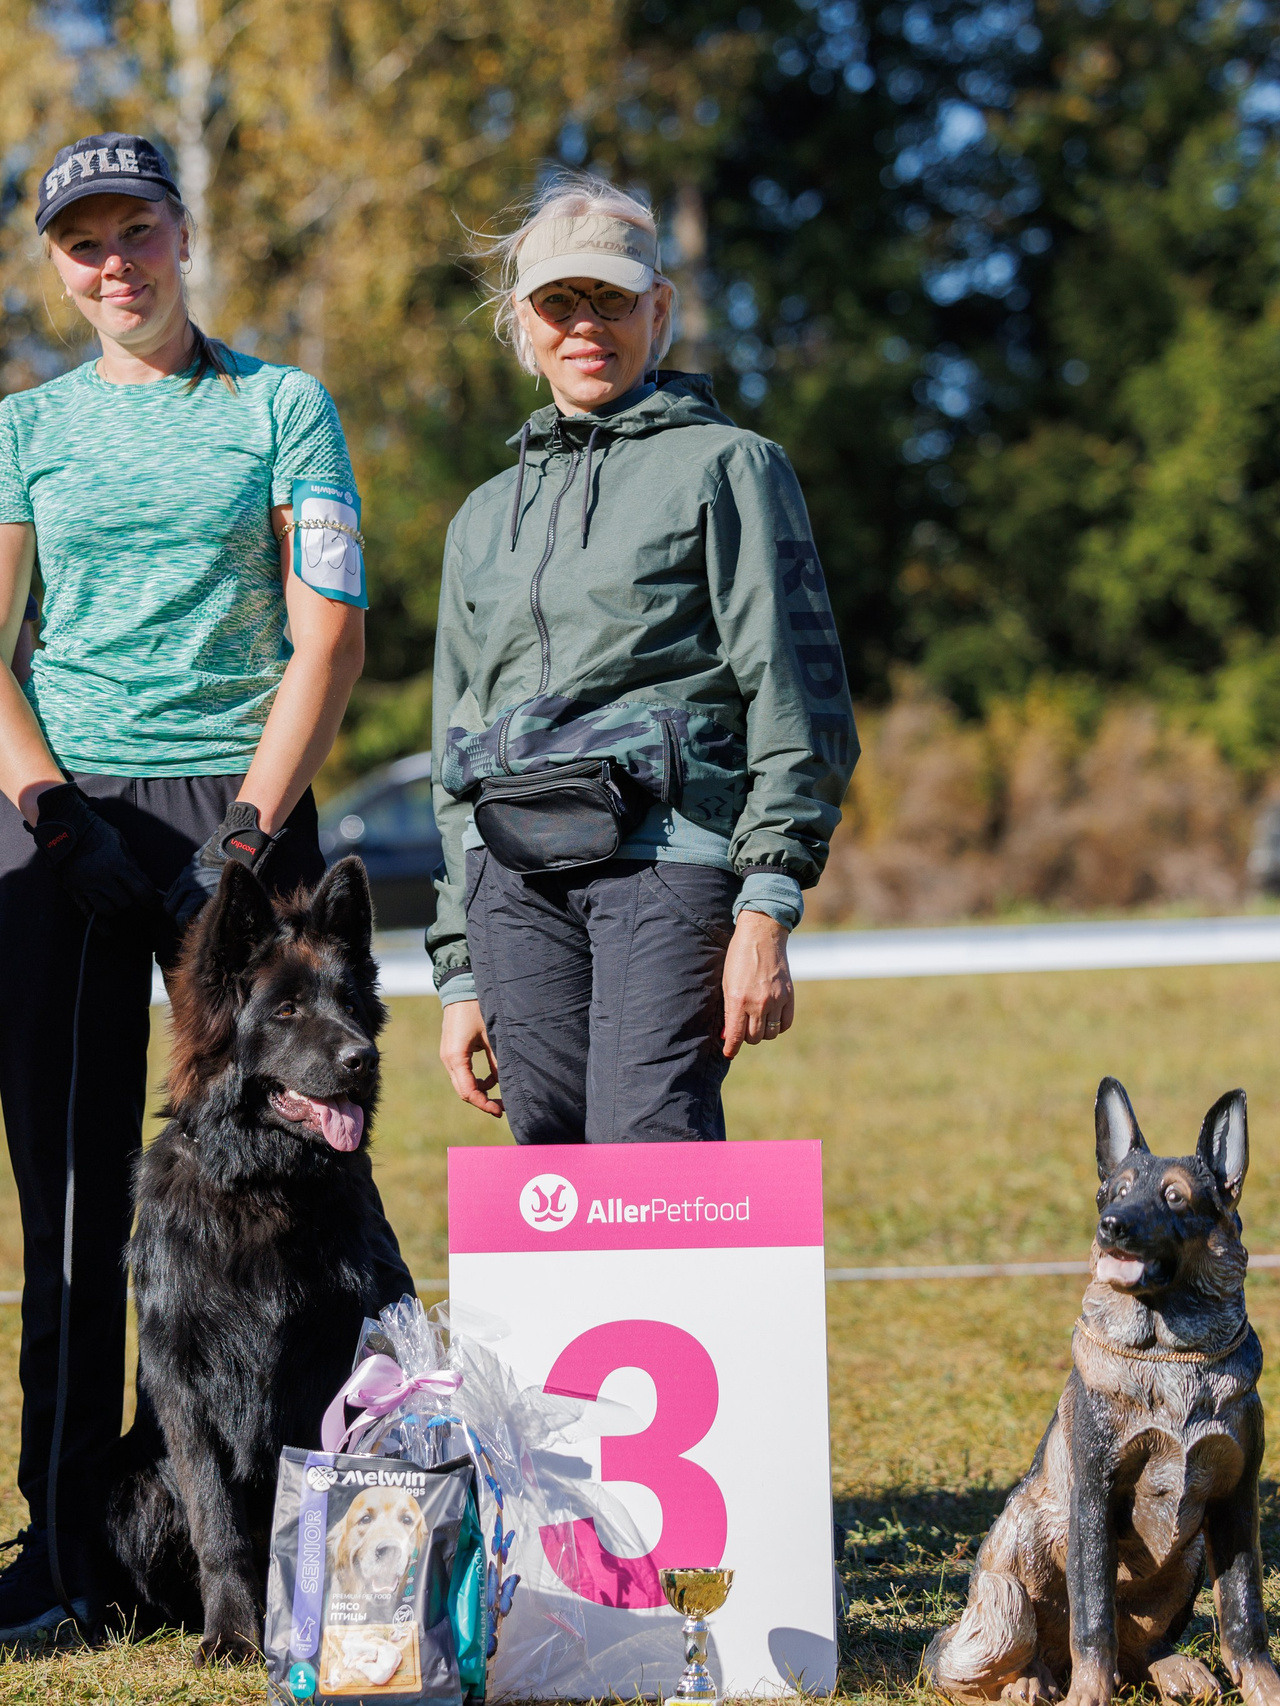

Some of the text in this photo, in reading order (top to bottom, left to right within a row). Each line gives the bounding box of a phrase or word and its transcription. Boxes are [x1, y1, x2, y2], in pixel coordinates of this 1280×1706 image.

[45, 147, 140, 200] STYLE
[575, 240, 641, 258] SALOMON
[311, 485, 344, 498] Melwin
[775, 540, 849, 765] RIDE
[586, 1196, 750, 1224] AllerPetfood
[538, 1319, 728, 1610] 3
[341, 1469, 426, 1486] Melwin
[400, 1485, 426, 1496] dogs
[300, 1509, 322, 1594] SENIOR
[478, 1584, 488, 1609] PET
[331, 1602, 360, 1611] МЯСО
[330, 1612, 367, 1623] ПТИЦЫ
[297, 1669, 307, 1684] 1
